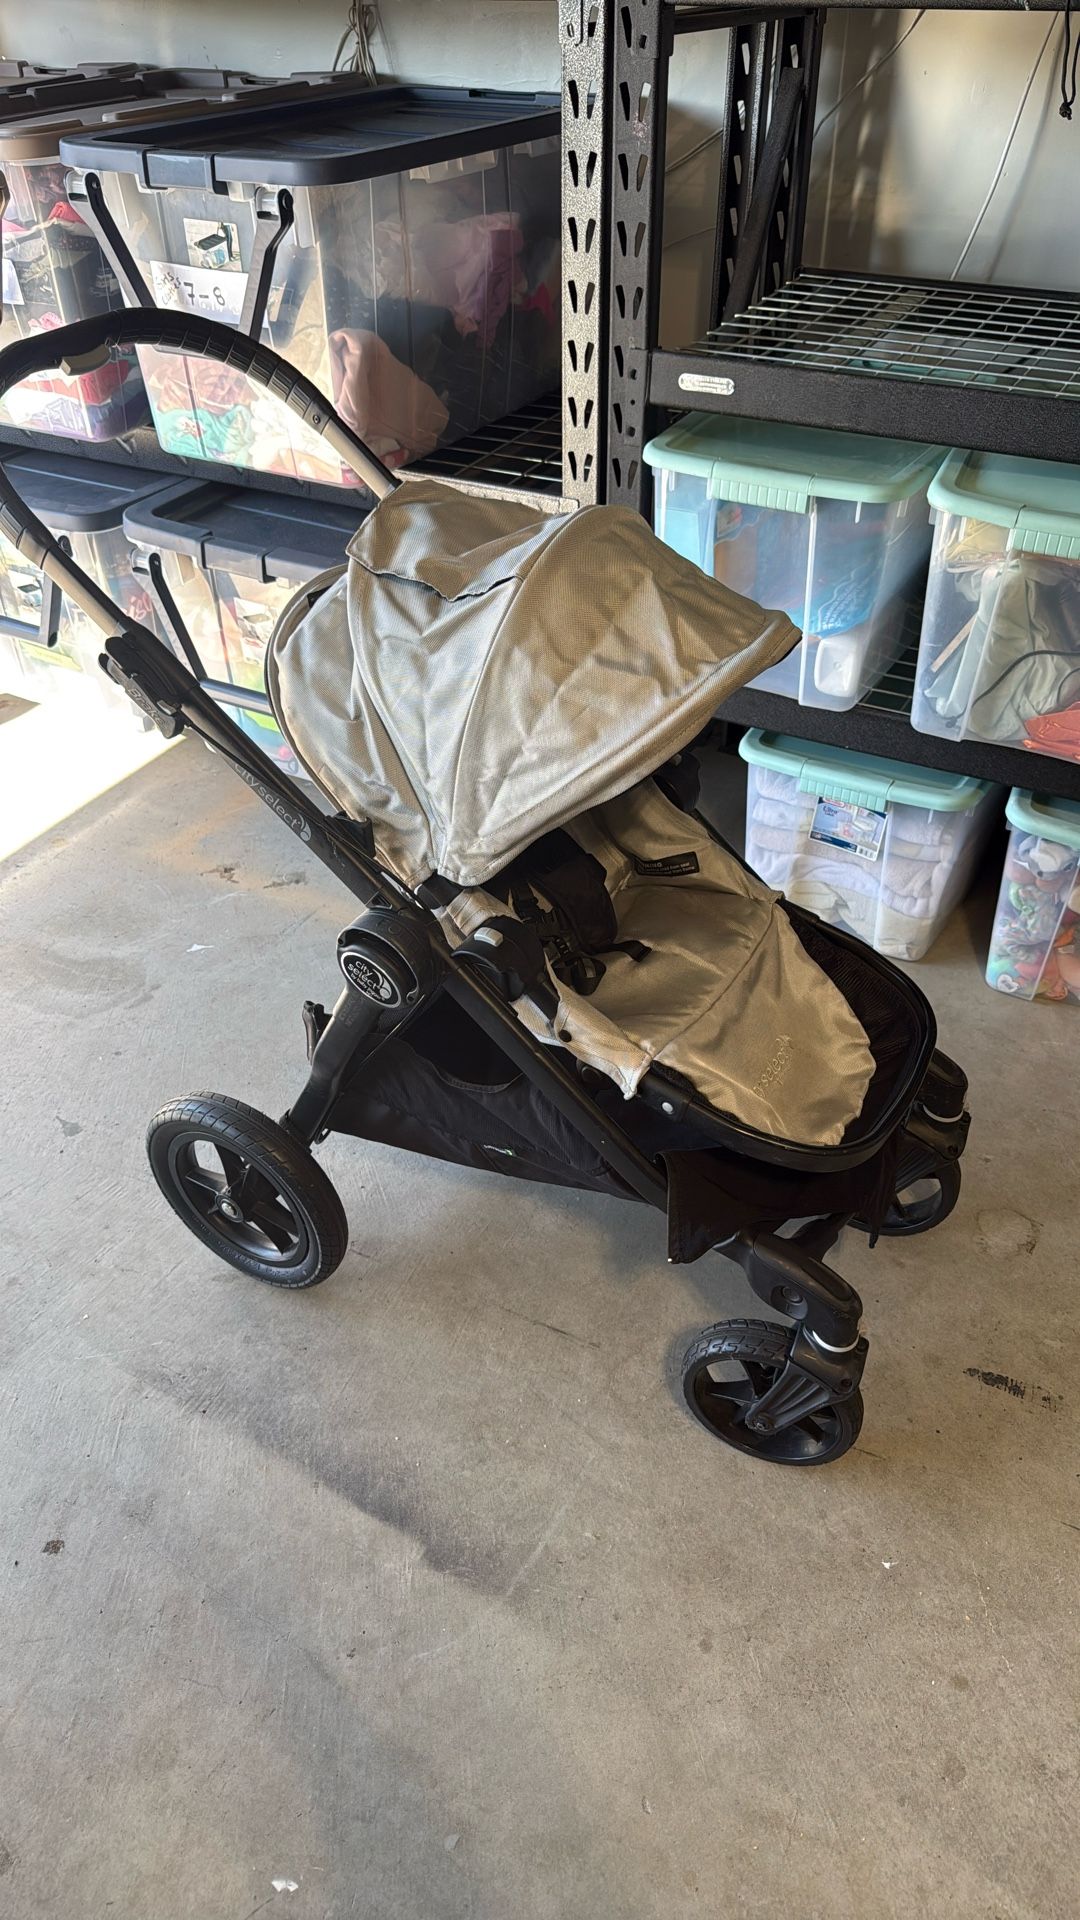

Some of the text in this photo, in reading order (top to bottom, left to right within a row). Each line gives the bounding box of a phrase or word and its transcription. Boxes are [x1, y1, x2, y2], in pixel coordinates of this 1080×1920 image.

[127, 687, 166, 727] Brake
[347, 963, 377, 990] select
[355, 960, 373, 977] city
